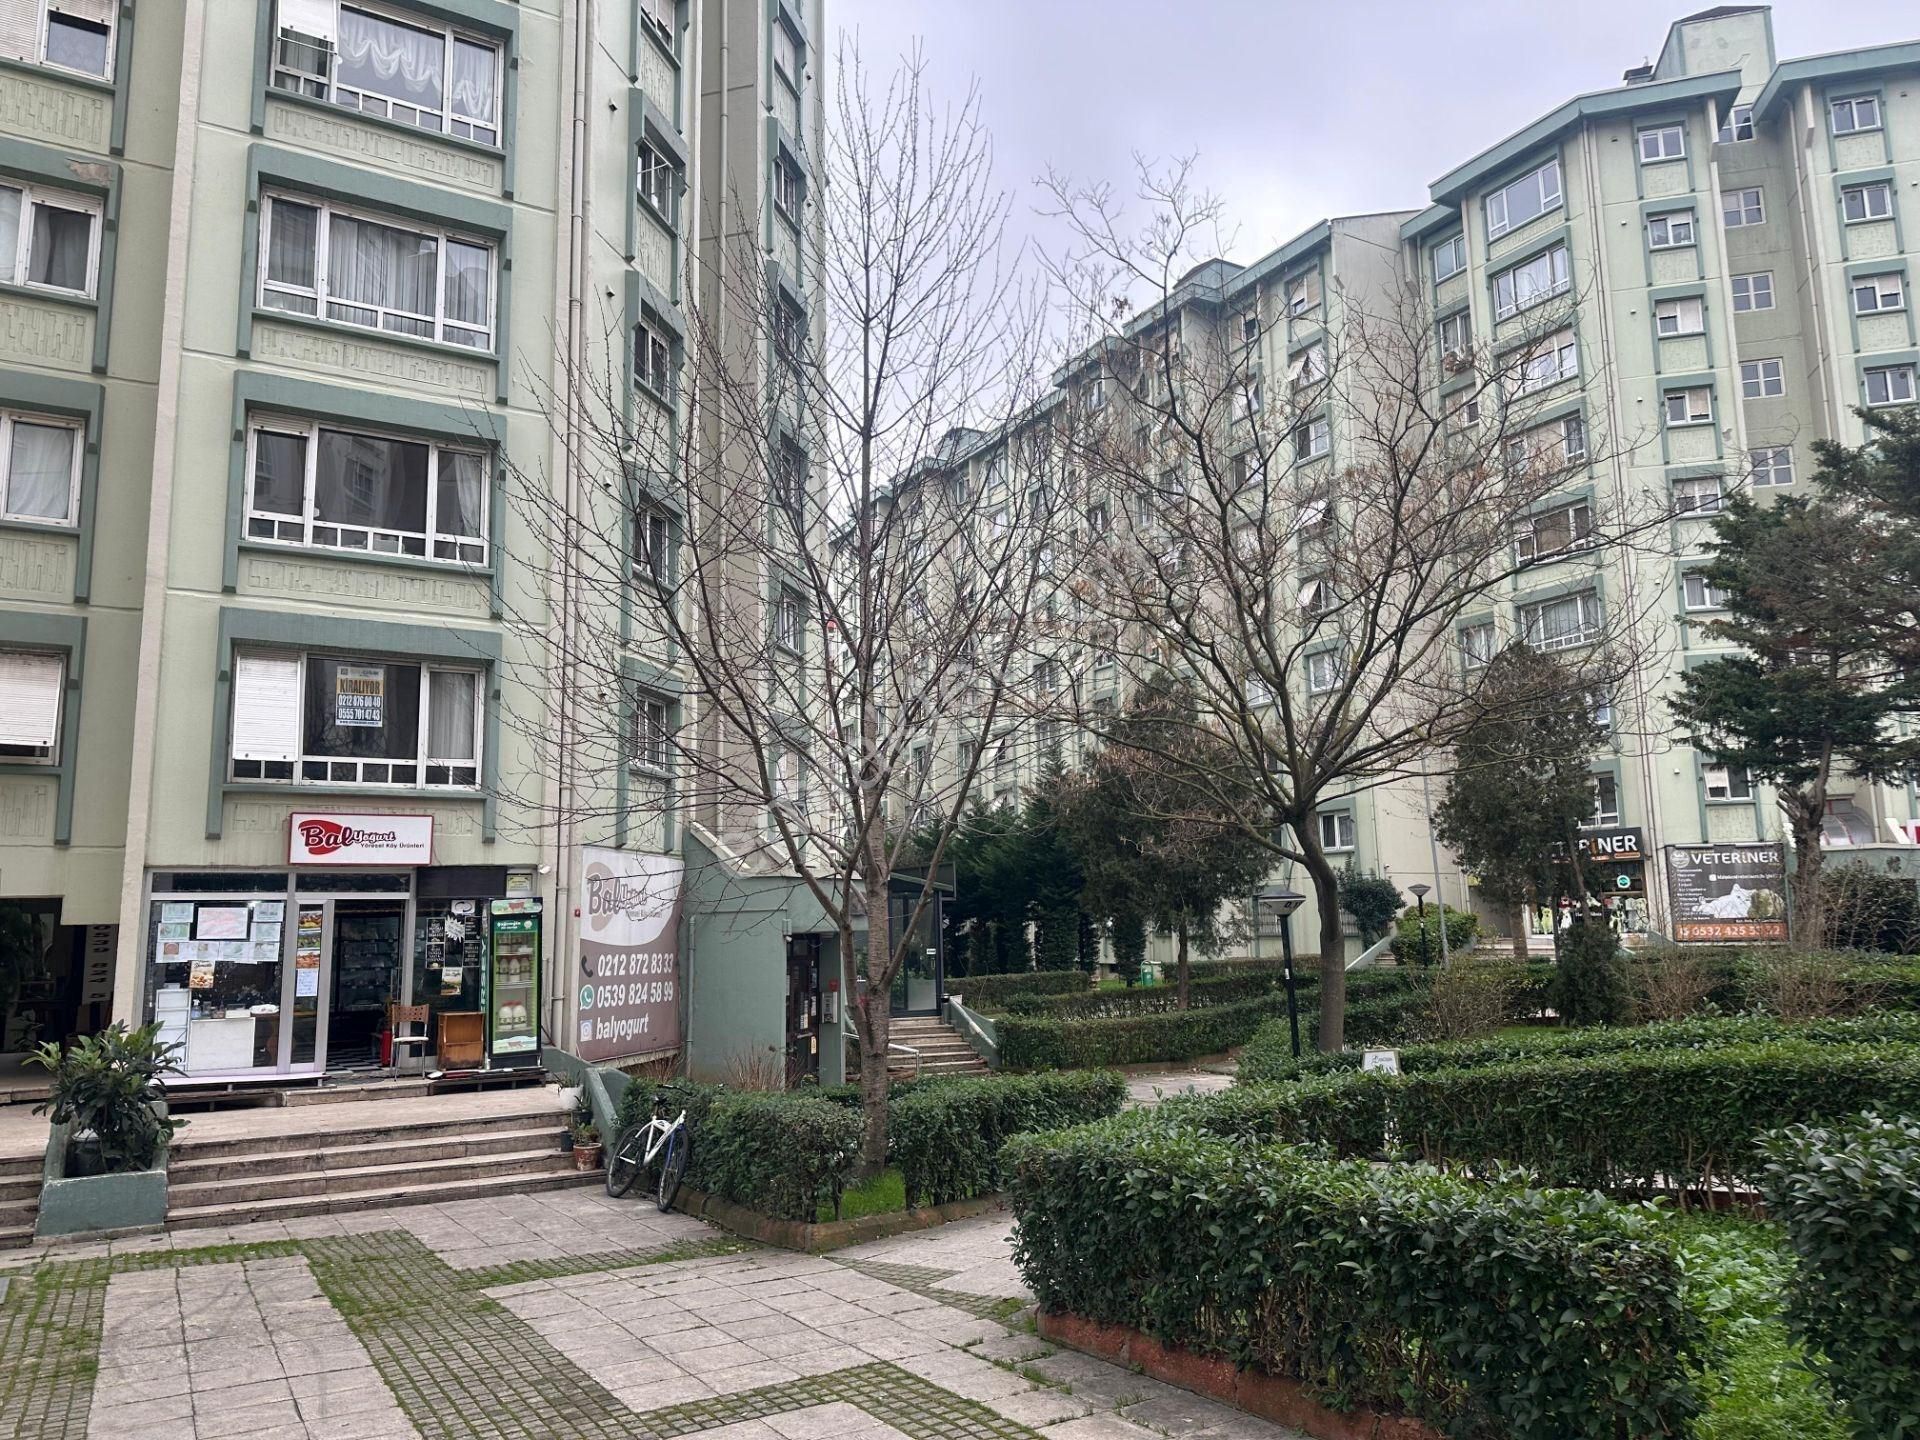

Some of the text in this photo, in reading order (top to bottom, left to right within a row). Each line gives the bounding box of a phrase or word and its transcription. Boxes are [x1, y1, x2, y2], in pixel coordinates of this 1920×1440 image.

[340, 678, 380, 694] KİRALIYOR
[338, 695, 353, 706] 0212
[338, 708, 354, 719] 0555
[355, 709, 365, 719] 701
[299, 825, 353, 848] Bal
[597, 953, 674, 977] 0212 872 83 33
[596, 981, 674, 1008] 0539 824 58 99
[595, 1013, 649, 1043] balyogurt
